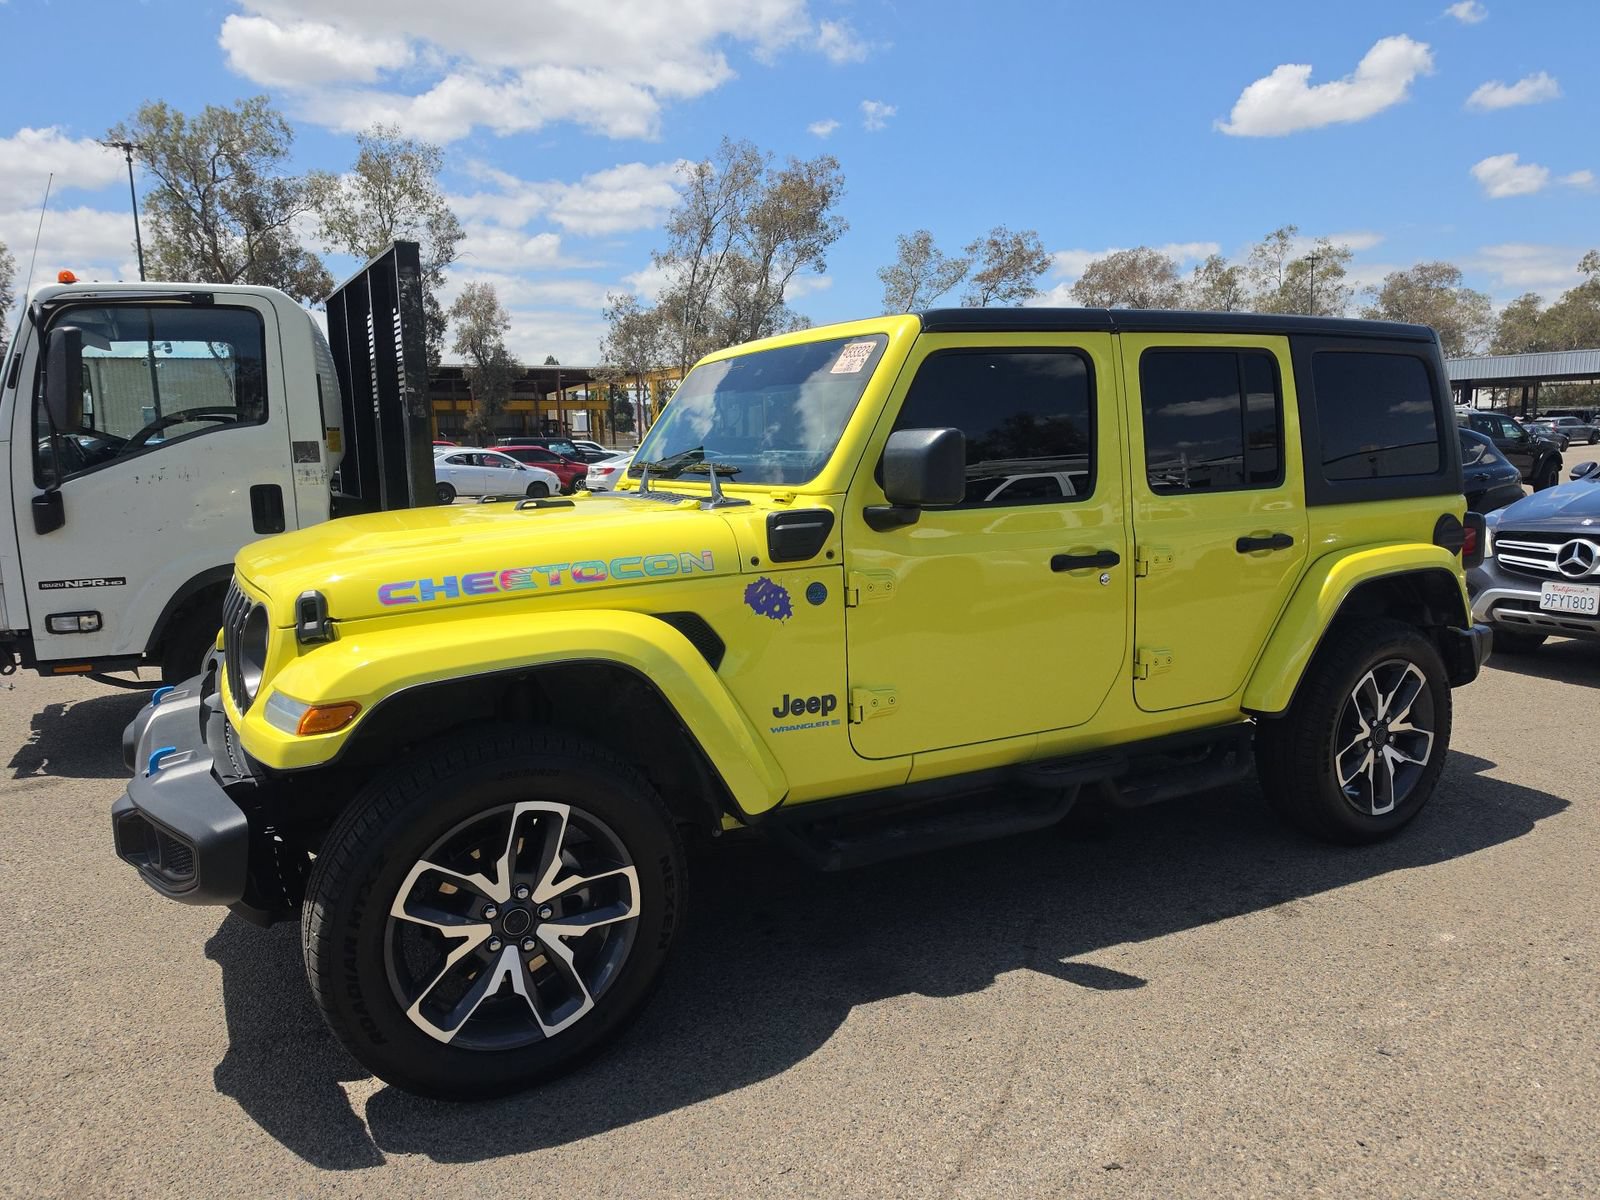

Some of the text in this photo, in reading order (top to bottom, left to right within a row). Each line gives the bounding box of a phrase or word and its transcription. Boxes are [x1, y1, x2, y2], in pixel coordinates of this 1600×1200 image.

[65, 579, 105, 588] NPR
[378, 550, 714, 606] CHEETOCON
[1552, 585, 1585, 594] California
[1543, 593, 1595, 611] 9FYT803
[772, 694, 837, 718] Jeep
[769, 720, 830, 734] WRANGLER
[657, 855, 676, 950] NEXEN
[342, 935, 389, 1045] ROADIAN
